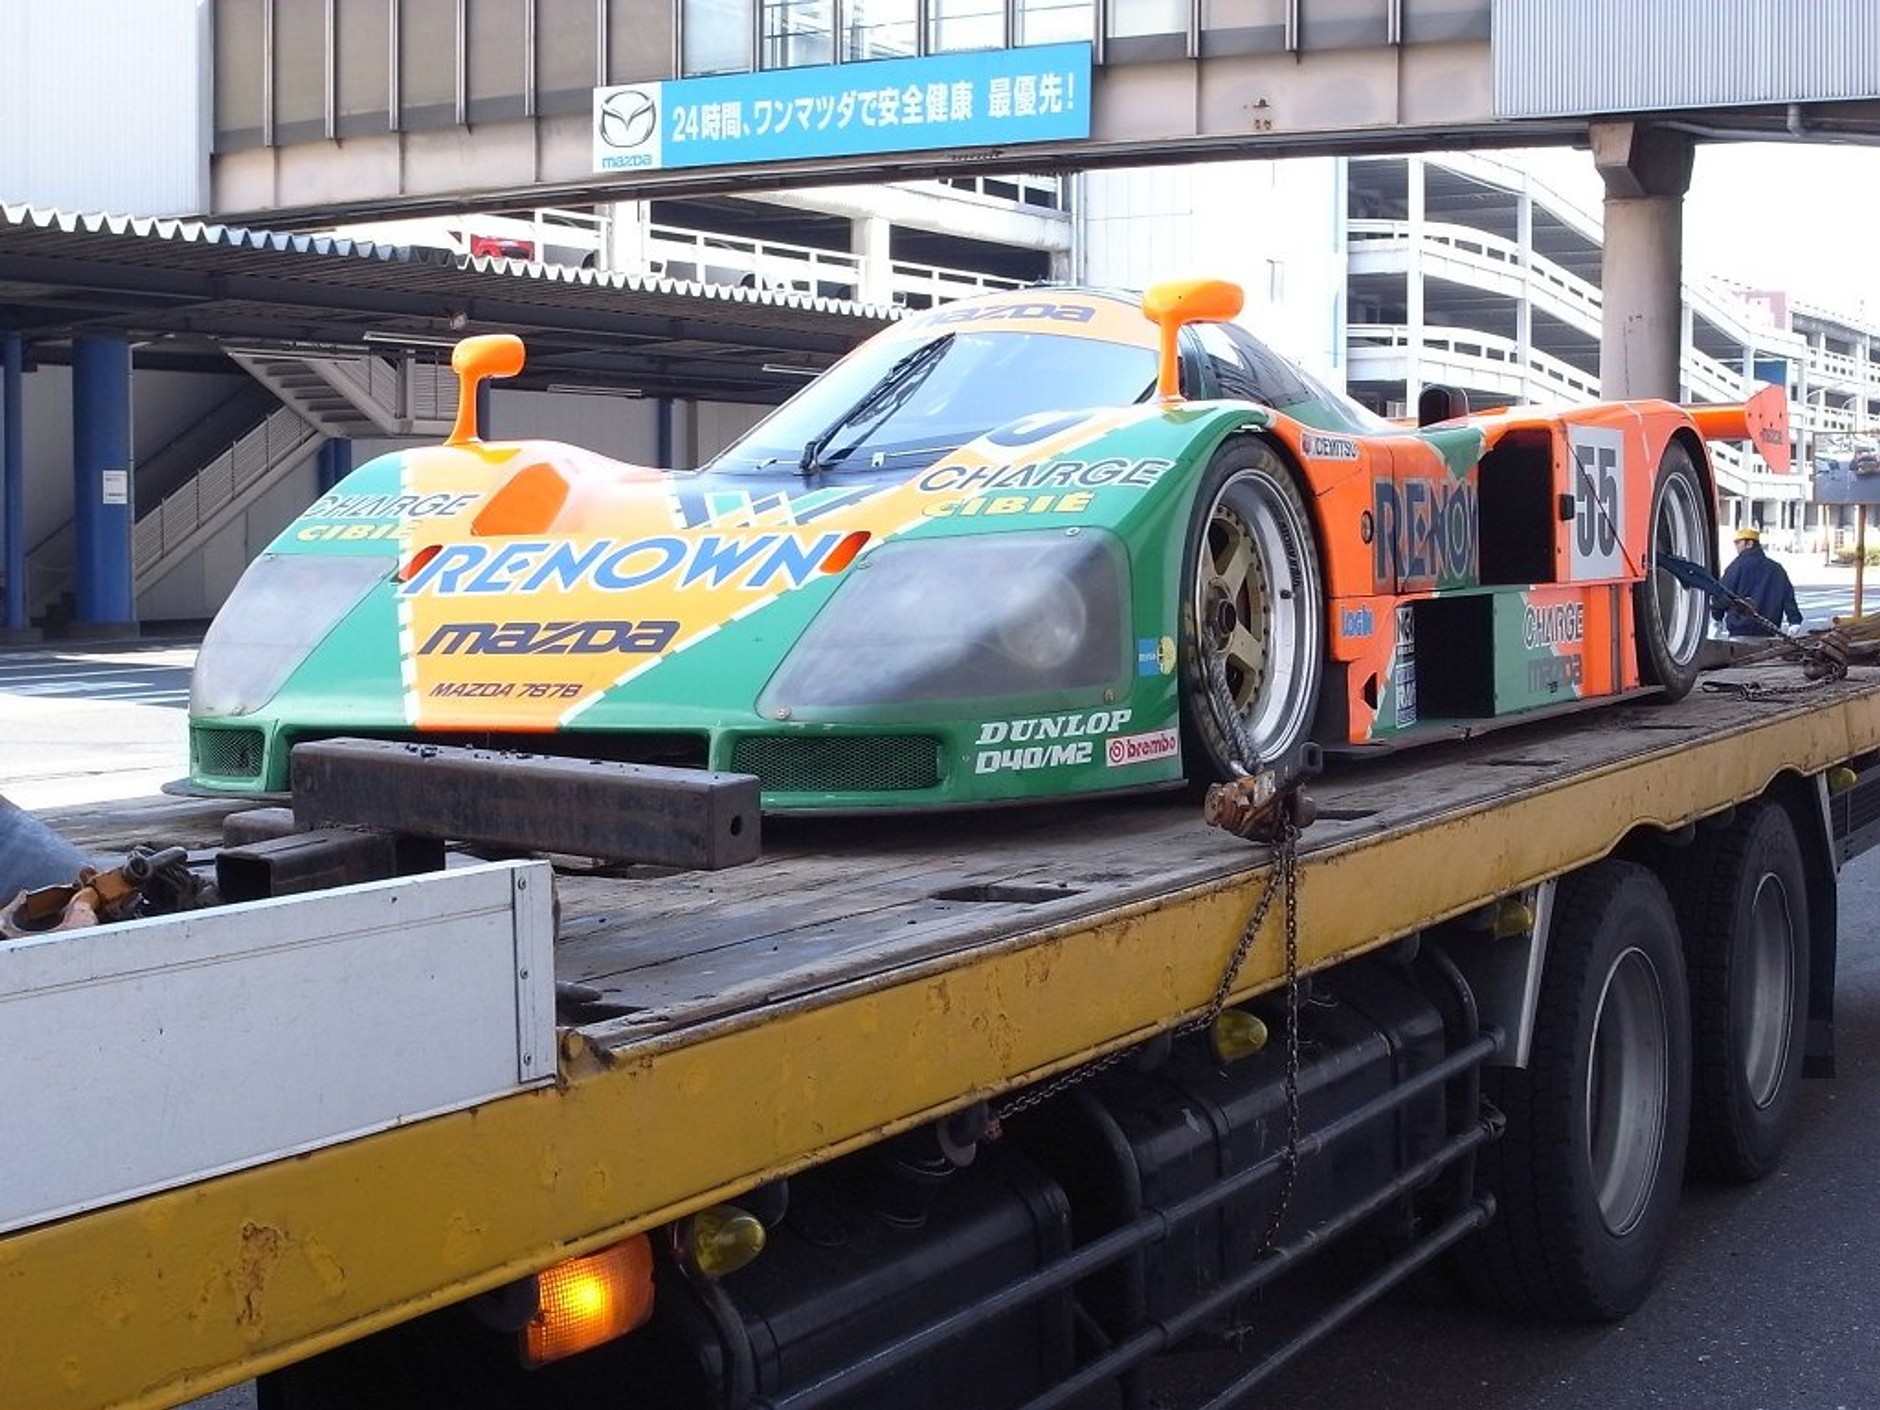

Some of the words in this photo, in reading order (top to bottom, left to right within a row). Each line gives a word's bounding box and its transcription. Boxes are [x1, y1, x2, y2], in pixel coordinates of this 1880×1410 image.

[672, 79, 974, 142] 24時間、ワンマツダで安全健康
[919, 460, 1171, 492] CHARGE
[303, 494, 478, 517] CHARGE
[1575, 444, 1617, 557] 55
[403, 532, 842, 594] RENOWN
[1523, 602, 1583, 649] CHARGE
[430, 683, 515, 697] MAZDA
[975, 709, 1132, 745] DUNLOP
[975, 741, 1093, 774] D40/M2
[1127, 733, 1176, 759] brembo
